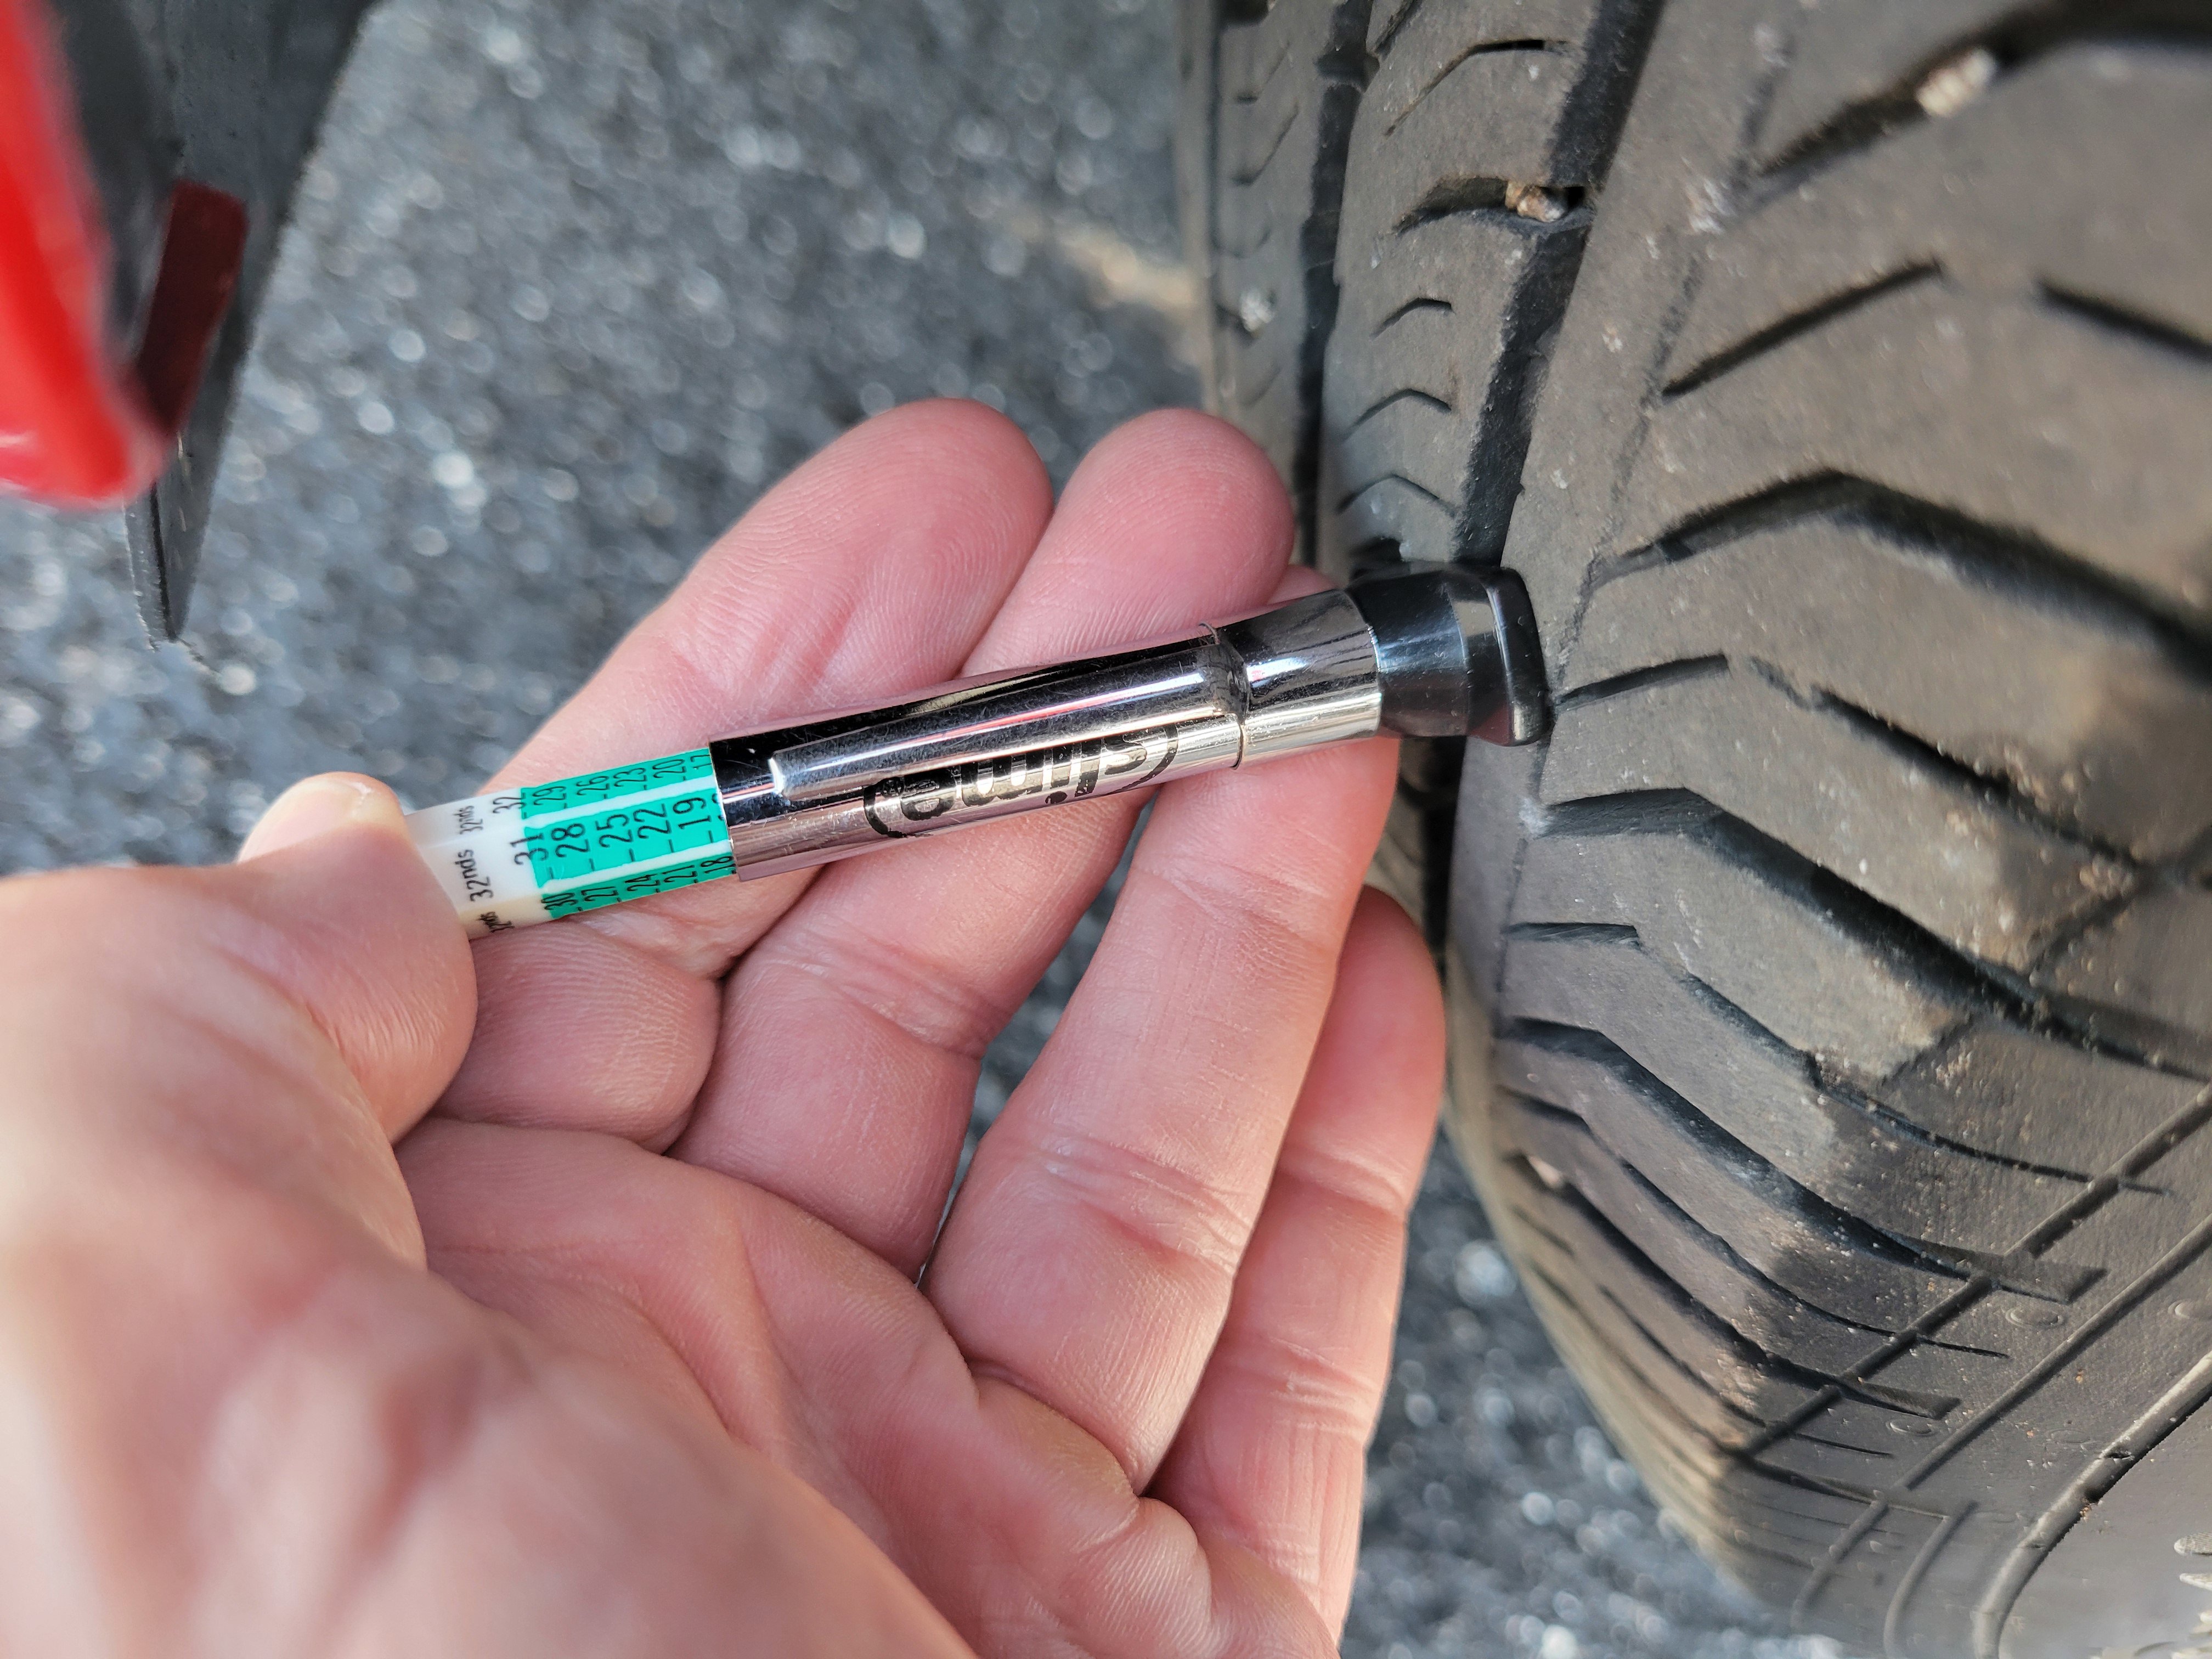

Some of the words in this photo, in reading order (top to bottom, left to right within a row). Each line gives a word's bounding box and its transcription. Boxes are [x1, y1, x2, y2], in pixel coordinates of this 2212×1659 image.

[613, 768, 647, 787] 23
[652, 759, 686, 778] 20
[576, 776, 610, 795] 26
[493, 792, 526, 814] 32
[532, 786, 567, 805] 29
[453, 805, 483, 835] 32nds
[633, 803, 672, 839] 22
[673, 797, 712, 830] 19
[551, 823, 590, 857] 28
[596, 814, 633, 848] 25
[510, 833, 548, 865] 31
[661, 865, 698, 883] 21
[700, 856, 736, 874] 18
[455, 850, 493, 902] 32nds
[624, 874, 661, 891] 24
[541, 893, 578, 910] 30
[581, 886, 619, 901] 27
